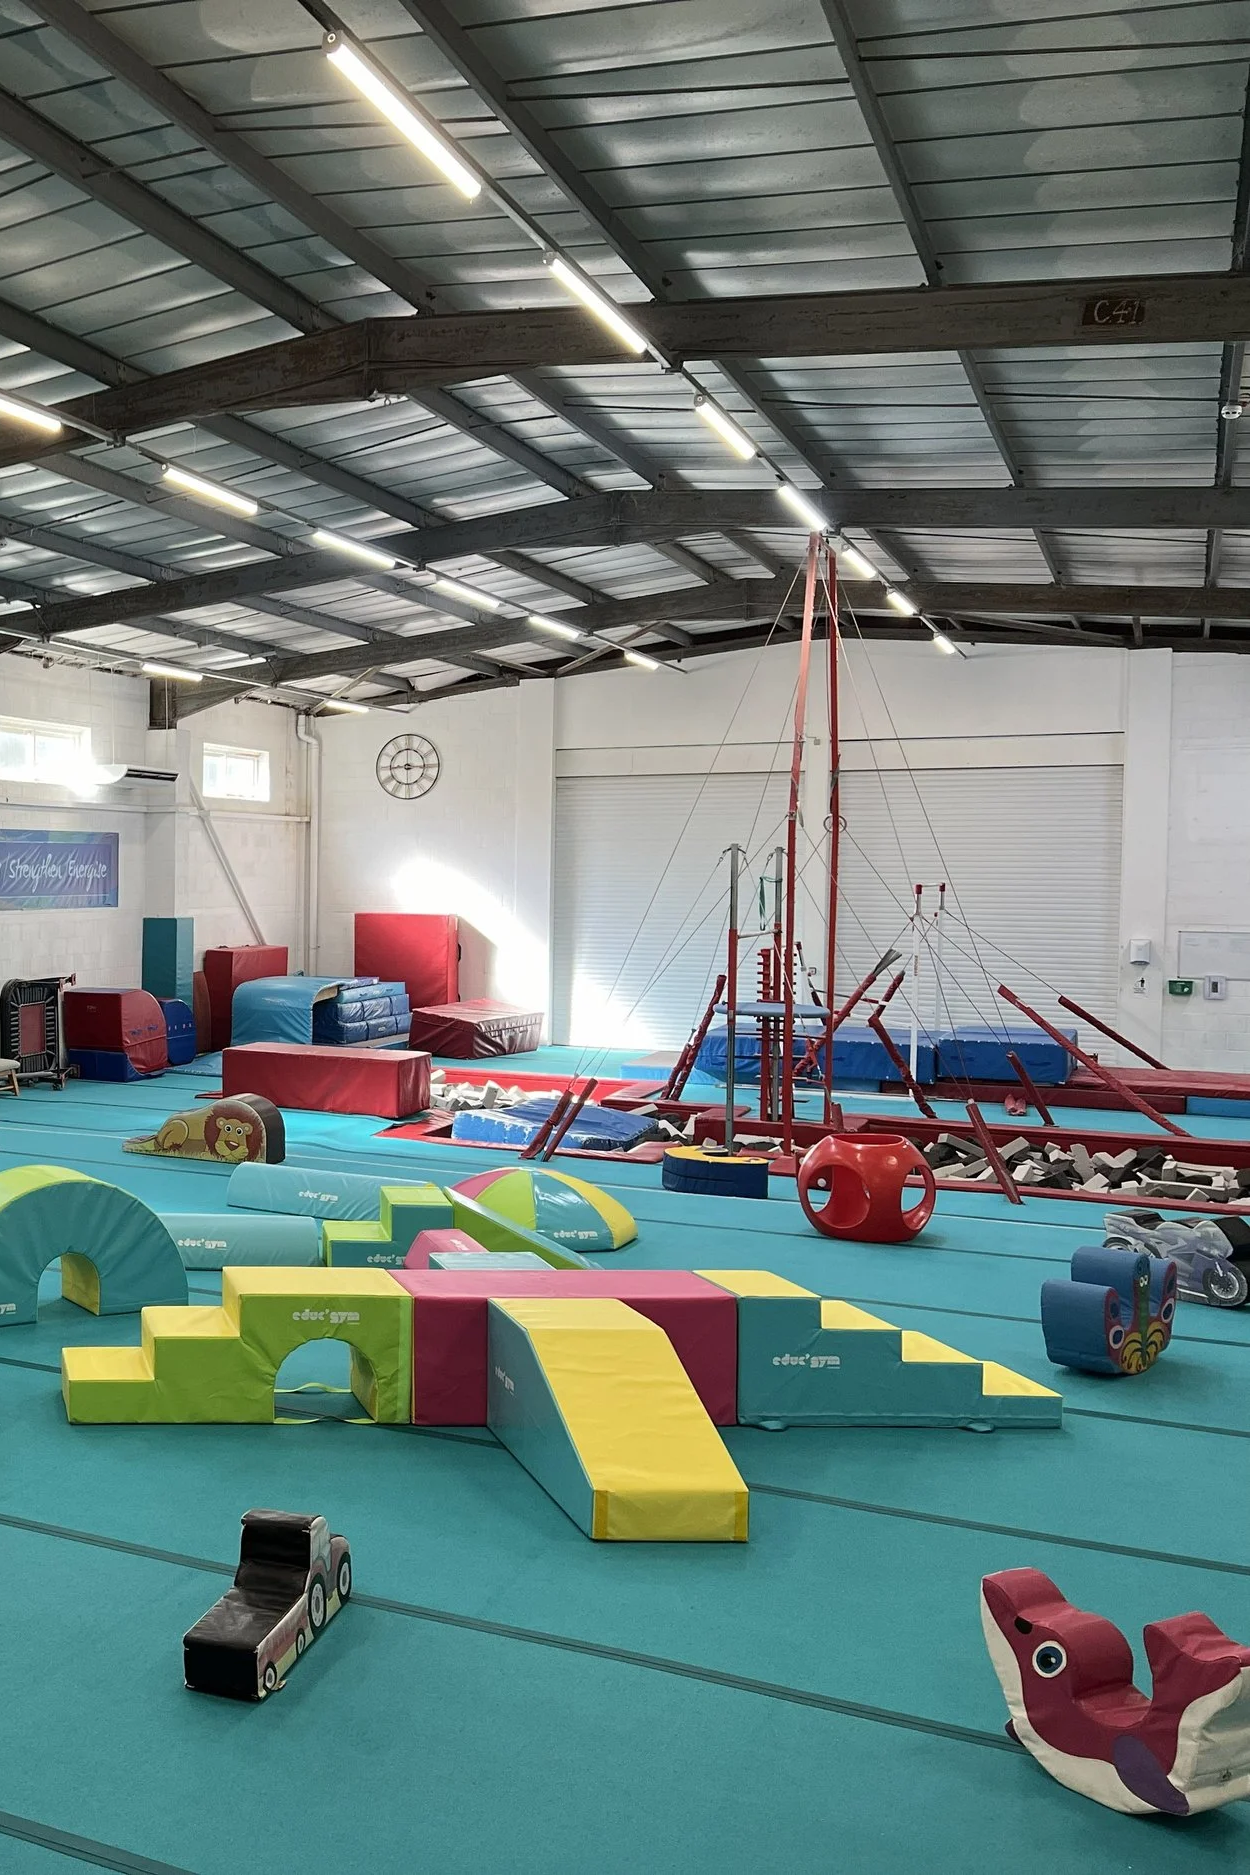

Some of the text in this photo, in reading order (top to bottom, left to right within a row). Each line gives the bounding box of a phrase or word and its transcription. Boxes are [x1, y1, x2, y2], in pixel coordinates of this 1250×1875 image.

[8, 853, 63, 893] Strengthen
[68, 859, 107, 893] Energise
[292, 1308, 360, 1324] educ'gym
[772, 1352, 841, 1369] educ'gym
